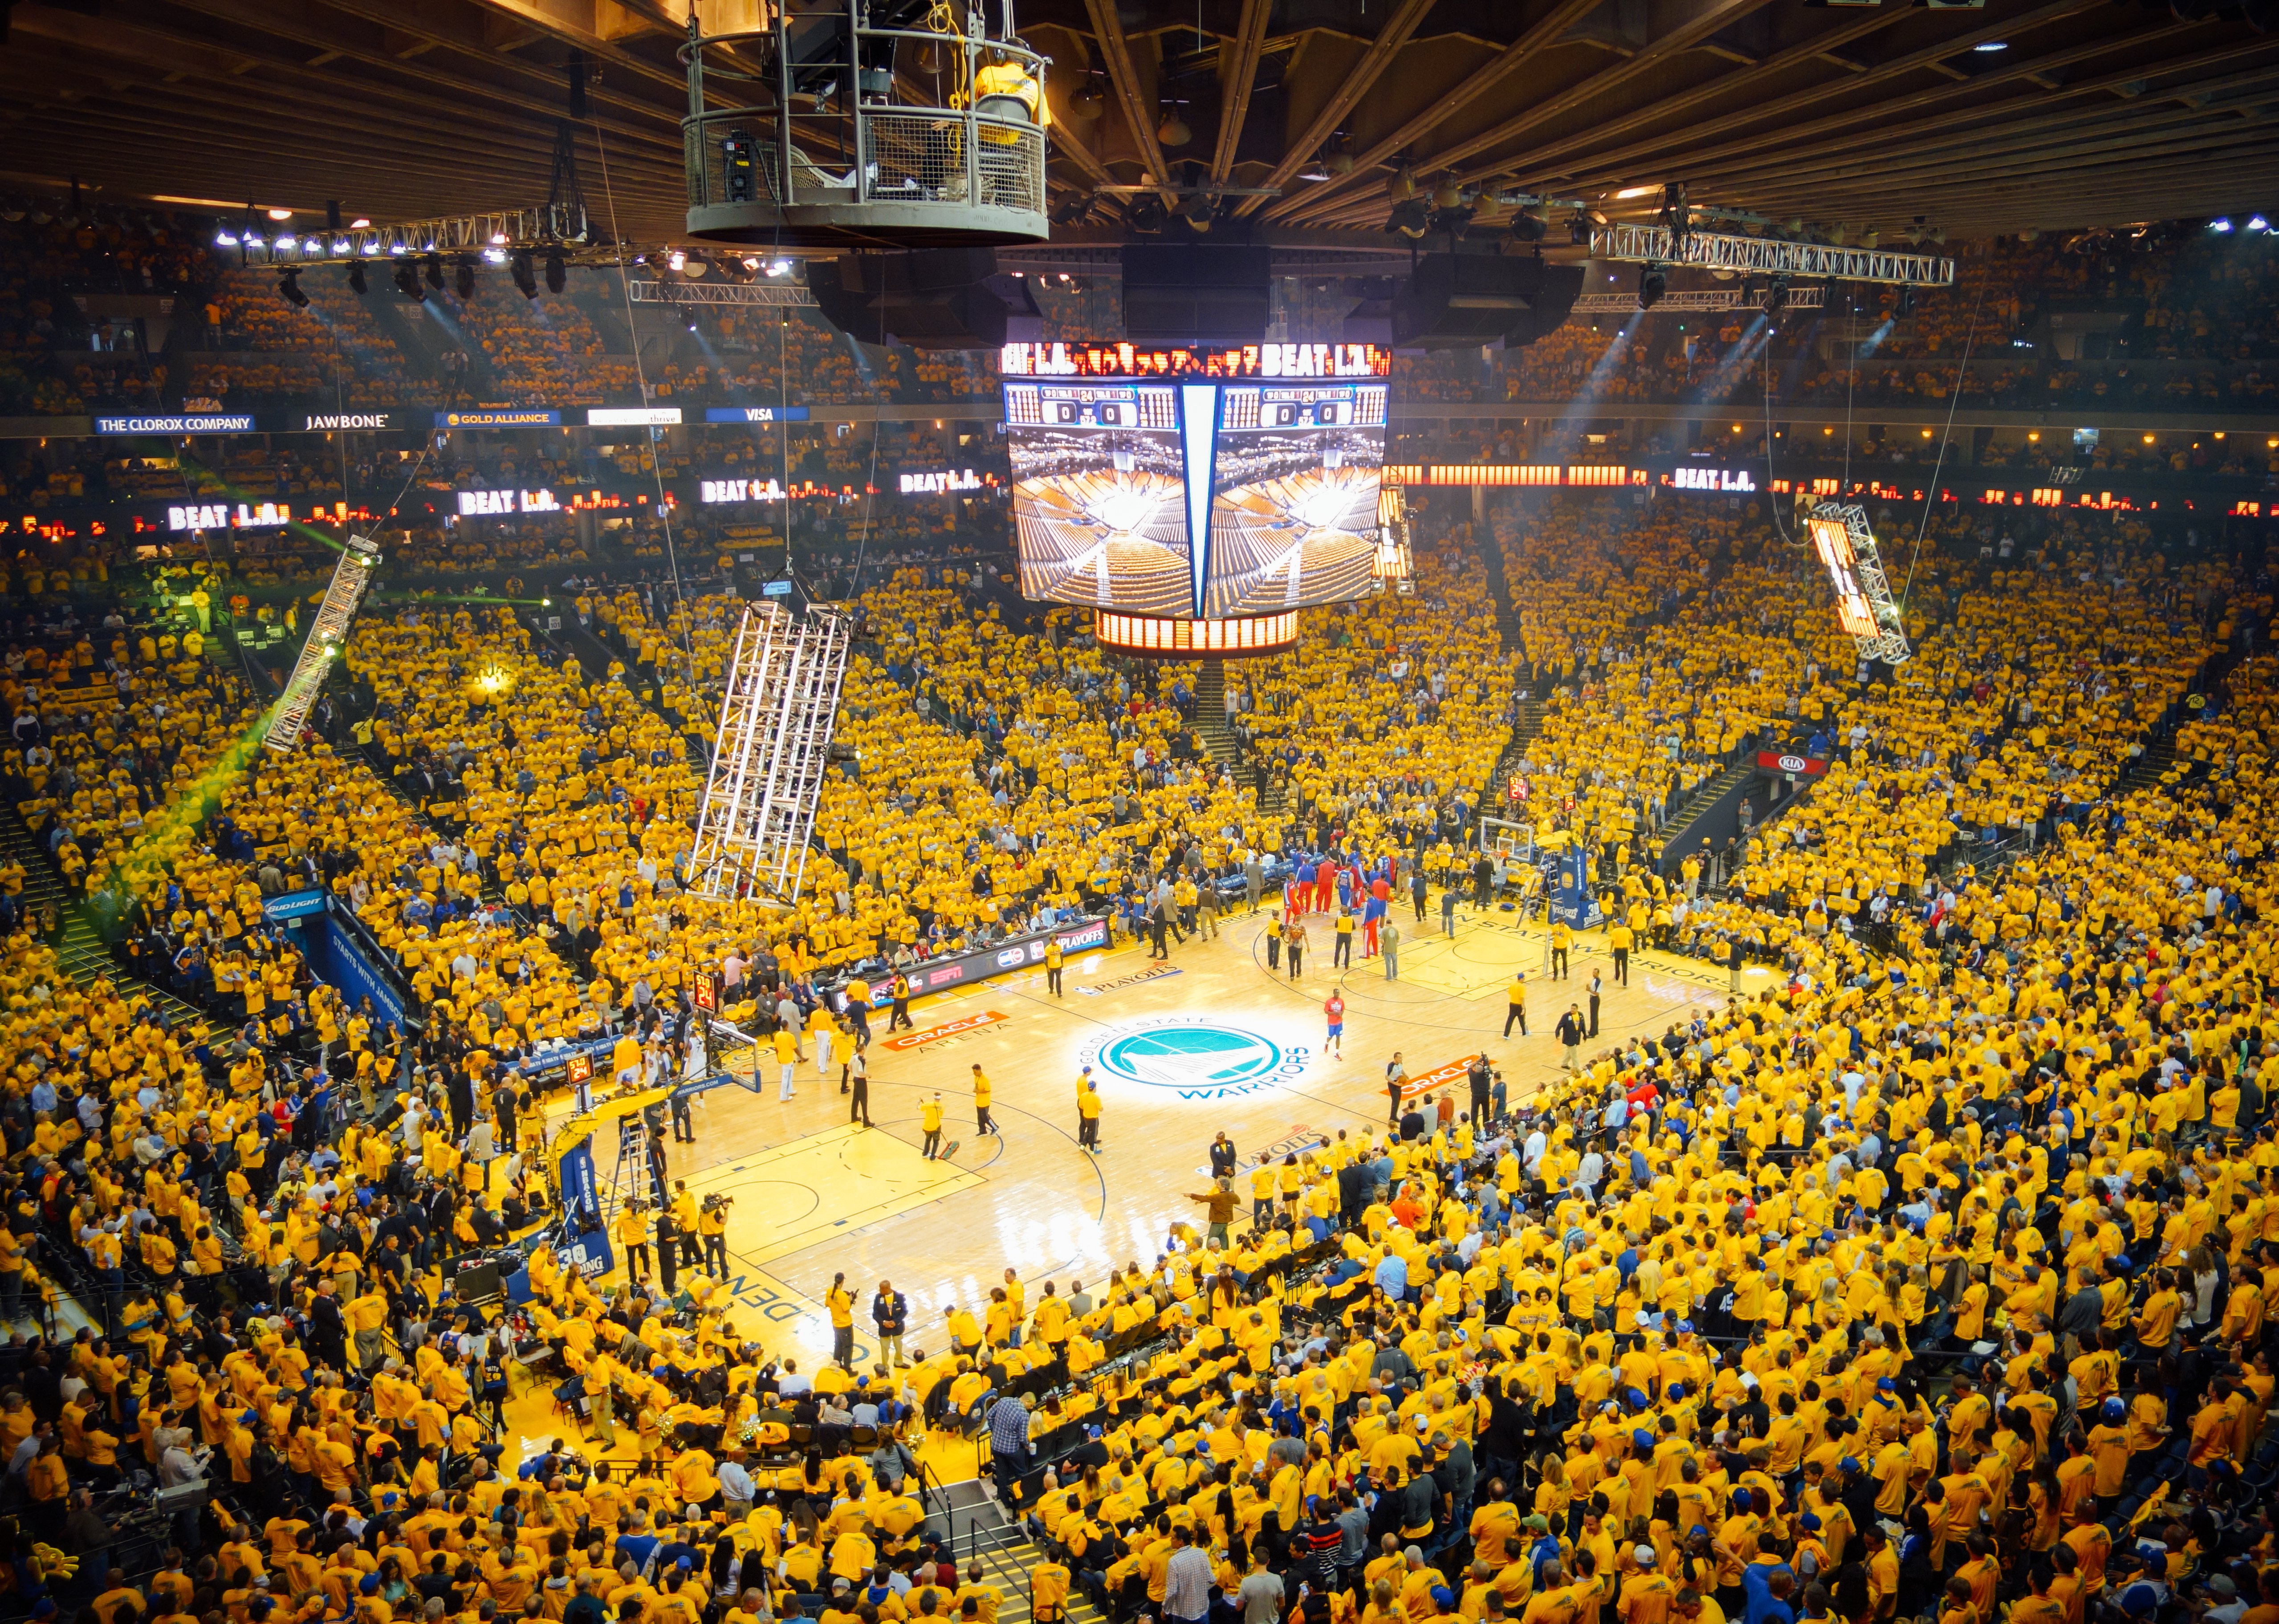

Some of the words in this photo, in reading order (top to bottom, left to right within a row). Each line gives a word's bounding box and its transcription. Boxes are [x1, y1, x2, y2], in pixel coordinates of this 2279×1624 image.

[1262, 344, 1327, 376] BEAT
[1335, 345, 1371, 376] L.A.
[306, 414, 386, 430] JAWBONE
[461, 414, 493, 424] GOLD
[495, 414, 549, 423] ALLIANCE
[651, 414, 675, 422] thrive
[746, 409, 773, 421] VISA
[1062, 406, 1070, 419] 0
[1107, 408, 1114, 421] 0
[1281, 409, 1289, 421] 0
[1324, 407, 1332, 420] 0
[99, 419, 127, 431] THE
[129, 418, 184, 430] CLOROX
[186, 417, 250, 431] COMPANY
[900, 473, 946, 493] BEAT
[948, 469, 981, 491] L.A.
[1675, 468, 1717, 490] BEAT
[1721, 470, 1755, 491] L.A.
[701, 480, 748, 503] BEAT
[753, 479, 785, 500] L.A.
[459, 490, 514, 515] BEAT
[521, 488, 560, 512] L.A.
[168, 504, 227, 531] BEAT
[238, 503, 288, 526] L.A.
[1783, 758, 1801, 768] KIA
[1510, 777, 1523, 785] 57.0
[1512, 784, 1526, 798] 24
[1588, 902, 1600, 917] 30
[1584, 913, 1604, 926] SPALDIN
[1060, 929, 1103, 949] PLAYOFFS
[1477, 921, 1553, 942] STAT
[333, 935, 357, 969] STARTS
[357, 965, 375, 990] WITH
[376, 984, 404, 1024] JAMBOX
[909, 977, 923, 988] abc
[930, 966, 963, 985] ESPN
[1094, 964, 1178, 991] PLAYOFFS
[698, 987, 712, 1007] 24
[898, 1015, 995, 1046] ORACLE
[1136, 1018, 1213, 1027] STATE
[919, 1023, 1013, 1054] ARENA
[1080, 1026, 1127, 1064] GOLDEN
[574, 1066, 588, 1080] 24
[1177, 1046, 1310, 1100] WARRIORS
[677, 1079, 719, 1096] WARRIORS.COM
[1237, 1130, 1324, 1169] LAYOFFS
[581, 1169, 594, 1213] NBA.COM
[558, 1243, 587, 1270] 30
[1178, 1264, 1191, 1278] 30
[1719, 1291, 1734, 1312] 45
